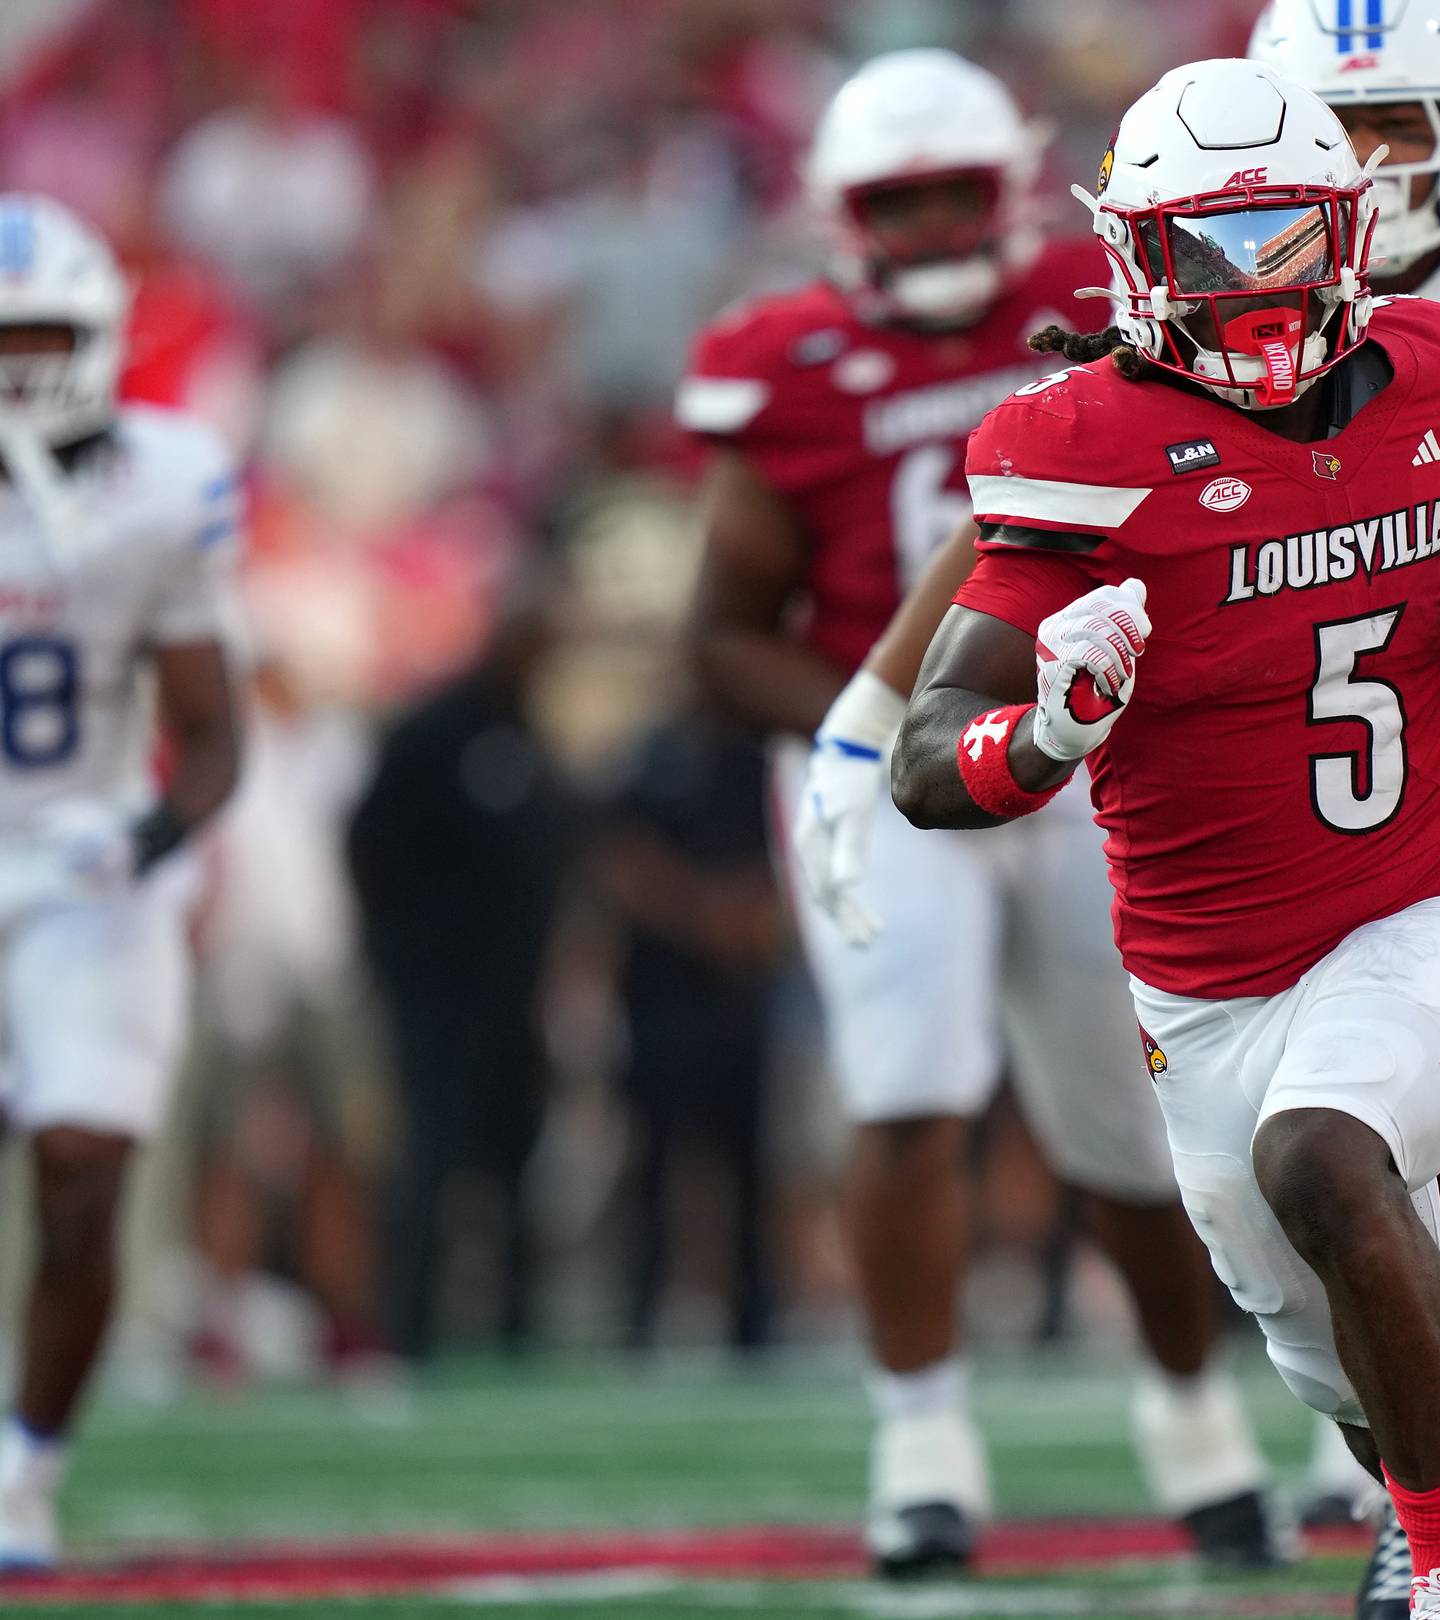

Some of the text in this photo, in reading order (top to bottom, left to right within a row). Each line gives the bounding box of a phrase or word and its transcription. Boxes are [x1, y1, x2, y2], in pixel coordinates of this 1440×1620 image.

[1223, 167, 1268, 188] ACC
[1262, 342, 1293, 390] NXTRND
[1169, 443, 1216, 465] L&N
[1209, 483, 1242, 502] ACC
[1306, 601, 1408, 836] 5
